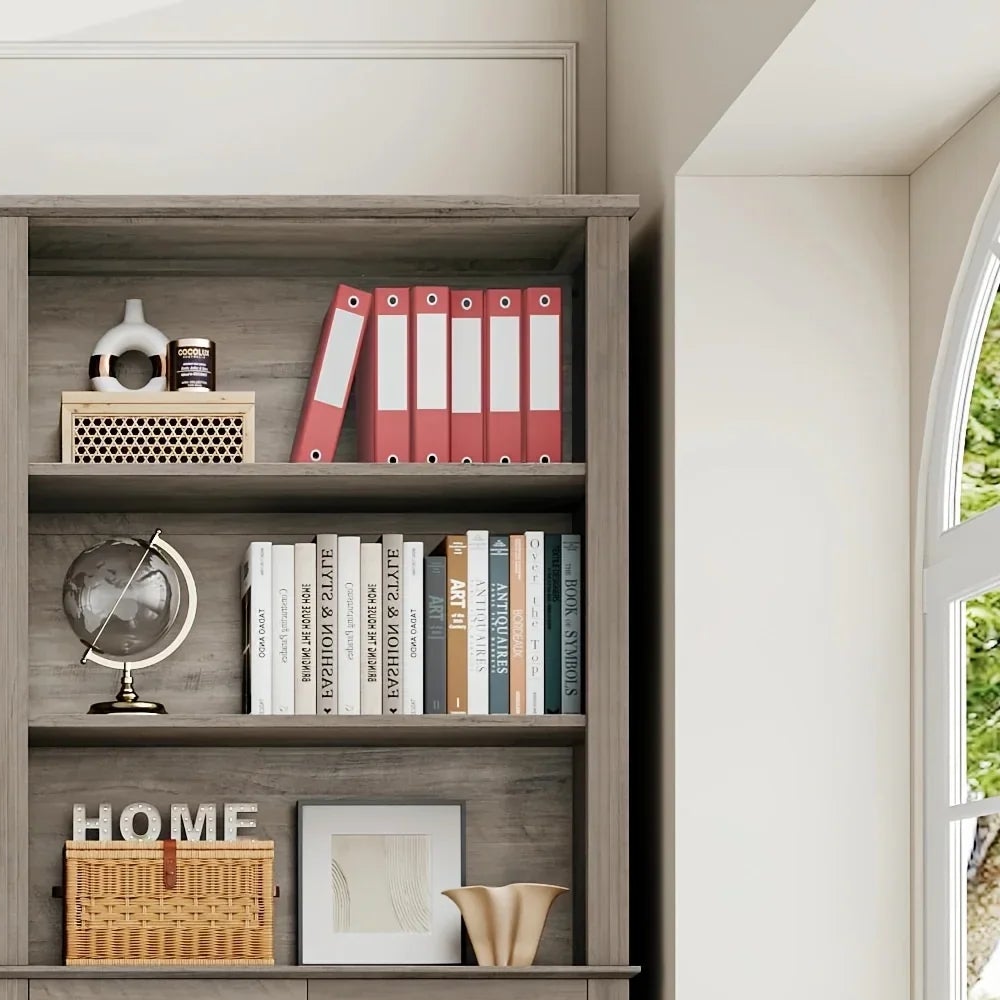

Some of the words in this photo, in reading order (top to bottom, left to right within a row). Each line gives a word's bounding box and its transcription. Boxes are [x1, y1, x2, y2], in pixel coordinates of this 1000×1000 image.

[428, 595, 444, 621] ART
[450, 579, 466, 609] ART
[565, 579, 578, 616] BOOK
[473, 579, 487, 672] ANTIQUAIRES
[495, 583, 508, 674] ANTIQUAIRES
[565, 630, 578, 696] SYMBOLS
[72, 802, 258, 841] HOME
